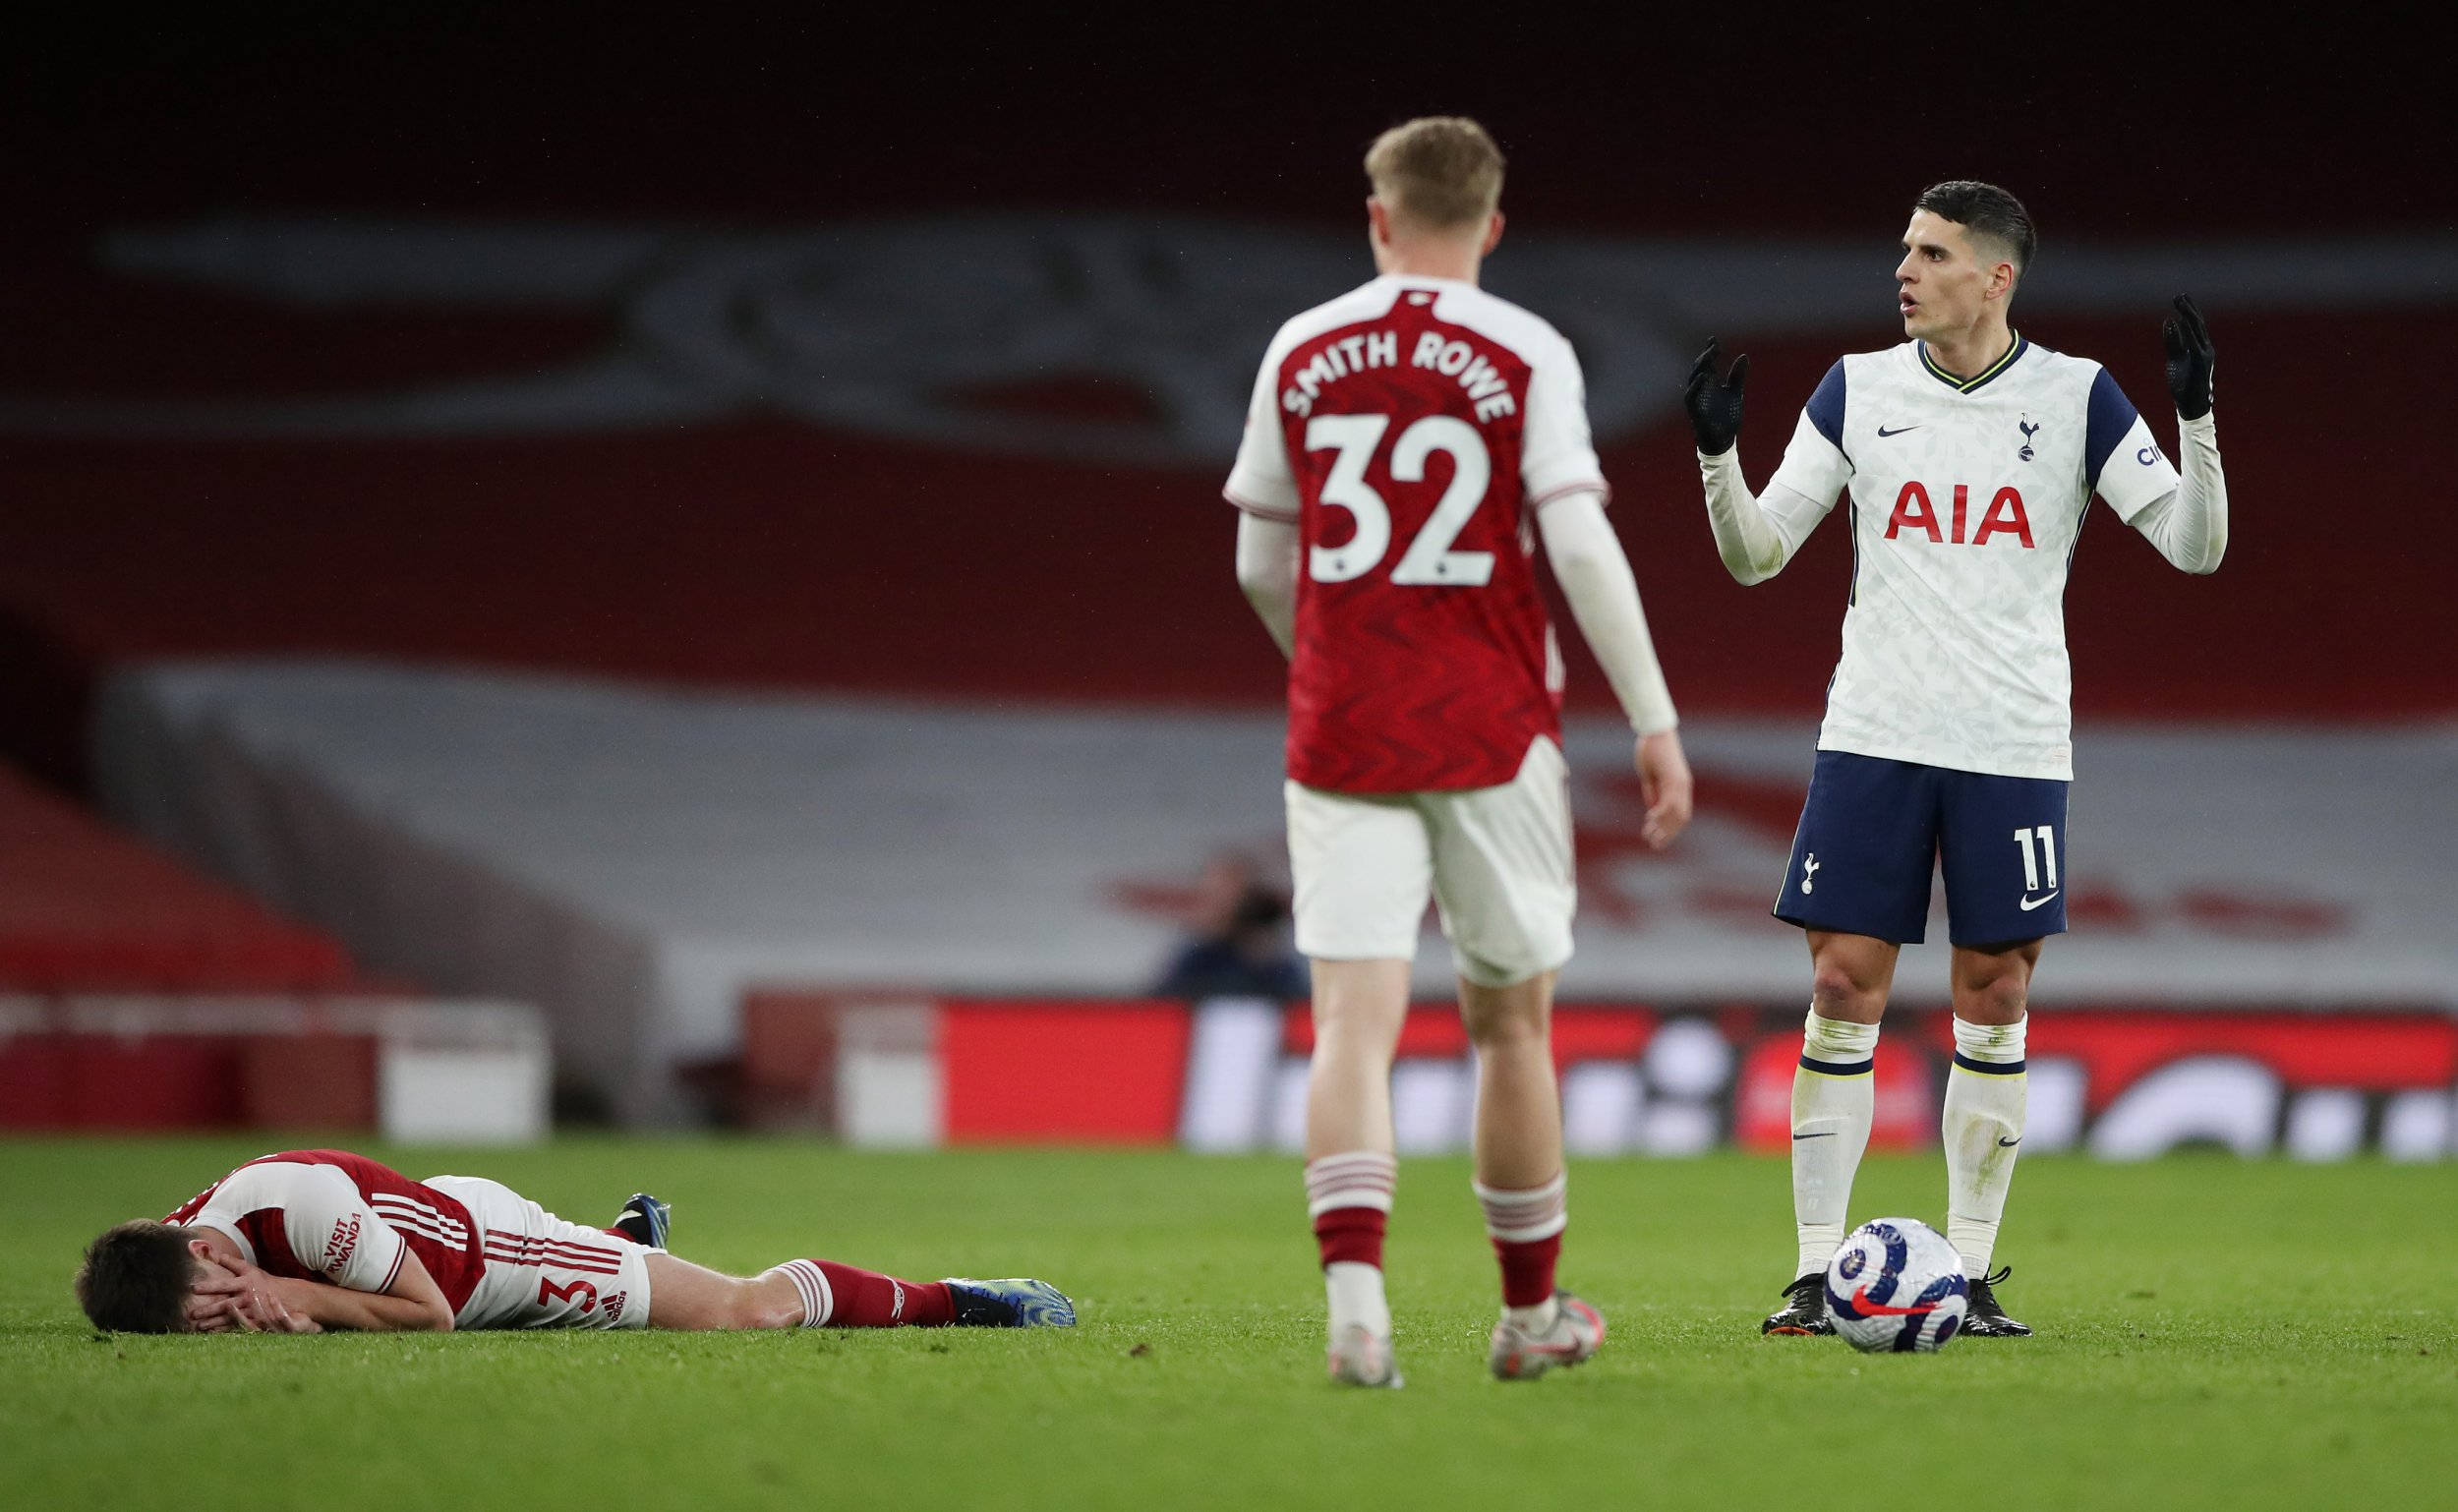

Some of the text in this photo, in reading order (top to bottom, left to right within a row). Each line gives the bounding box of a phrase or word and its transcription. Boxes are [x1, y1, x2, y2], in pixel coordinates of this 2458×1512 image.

[1282, 329, 1517, 425] SMITH ROWE
[1304, 413, 1496, 587] 32
[1884, 481, 2035, 549] AIA
[2014, 825, 2057, 891] 11
[323, 1218, 348, 1256] VISIT
[537, 1276, 597, 1314] 3
[611, 1290, 627, 1322] adidas
